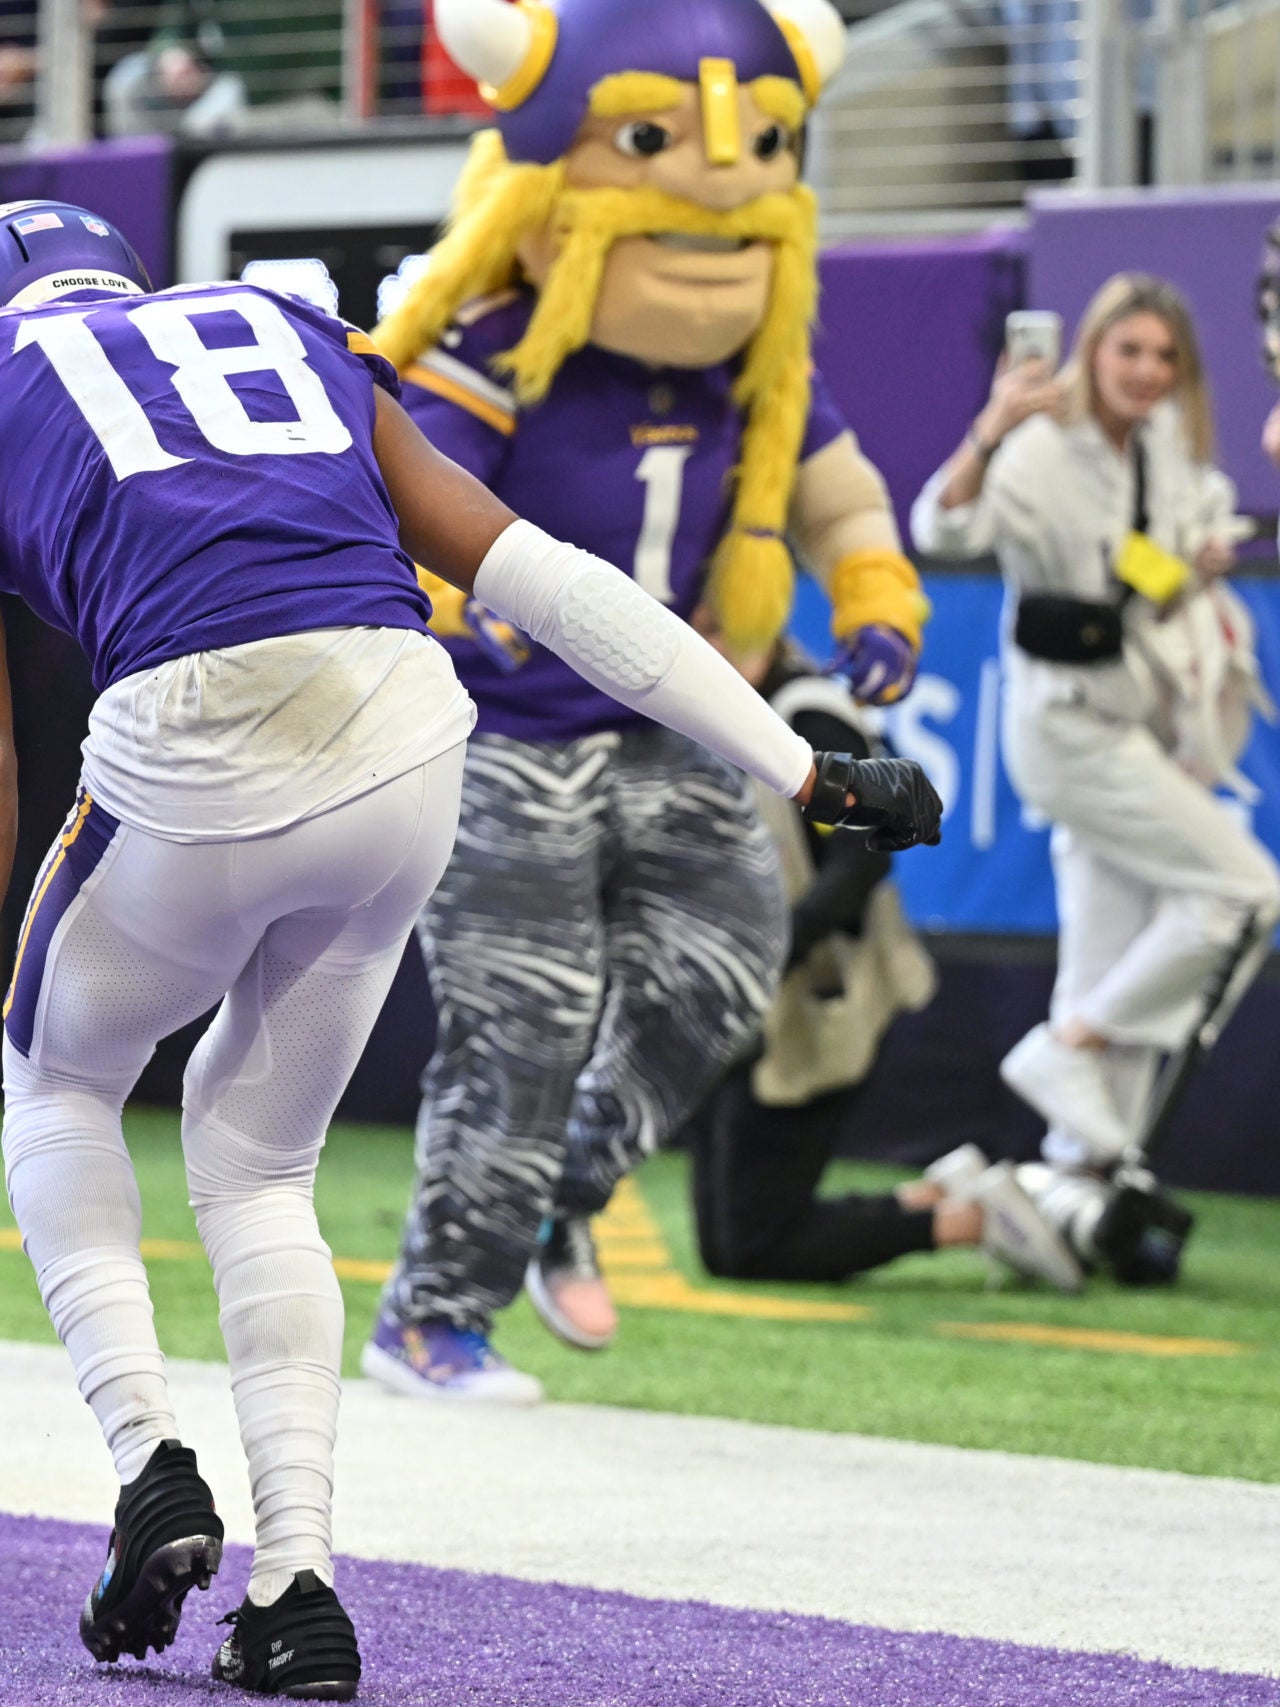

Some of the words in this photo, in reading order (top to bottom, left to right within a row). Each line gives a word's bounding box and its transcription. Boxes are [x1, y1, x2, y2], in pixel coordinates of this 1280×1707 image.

[52, 277, 99, 289] CHOOSE
[101, 278, 128, 290] LOVE
[12, 291, 353, 482] 18
[633, 445, 694, 604] 1
[270, 1639, 282, 1654] RIP
